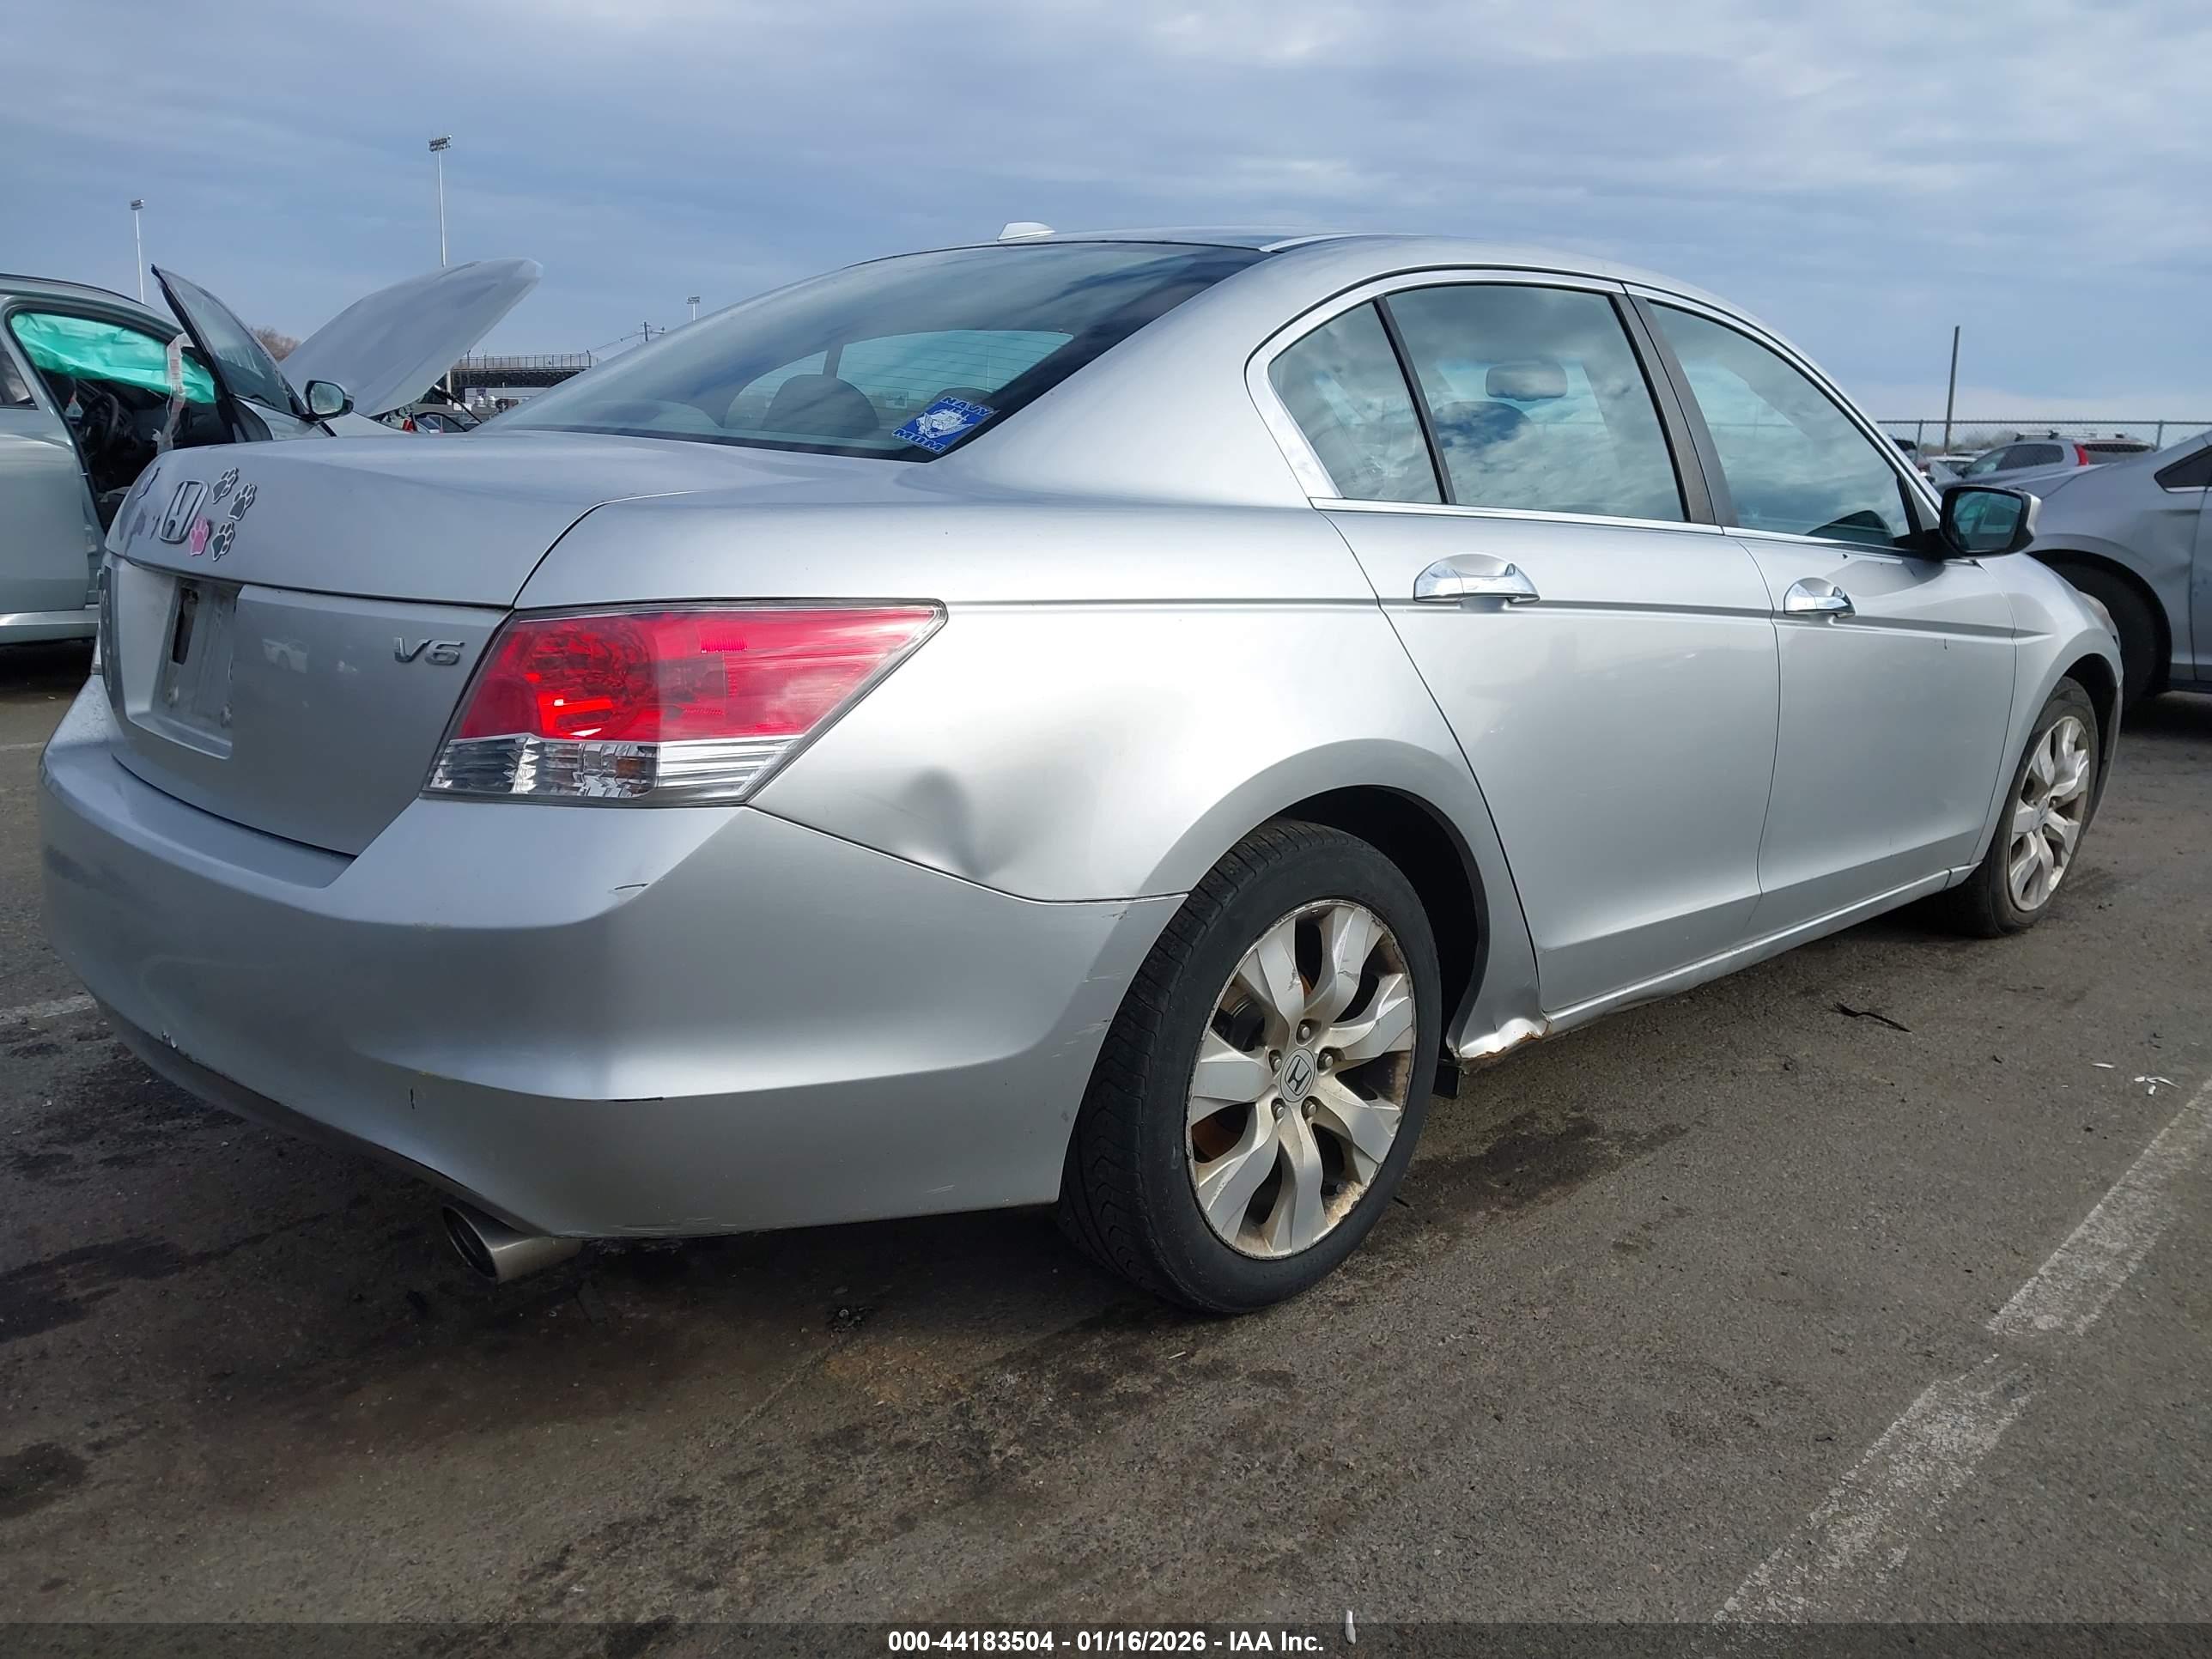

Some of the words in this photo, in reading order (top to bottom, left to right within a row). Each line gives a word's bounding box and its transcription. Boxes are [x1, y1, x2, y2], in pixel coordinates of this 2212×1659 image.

[939, 396, 994, 416] NAVY
[891, 428, 946, 453] MOM
[393, 636, 465, 665] V6
